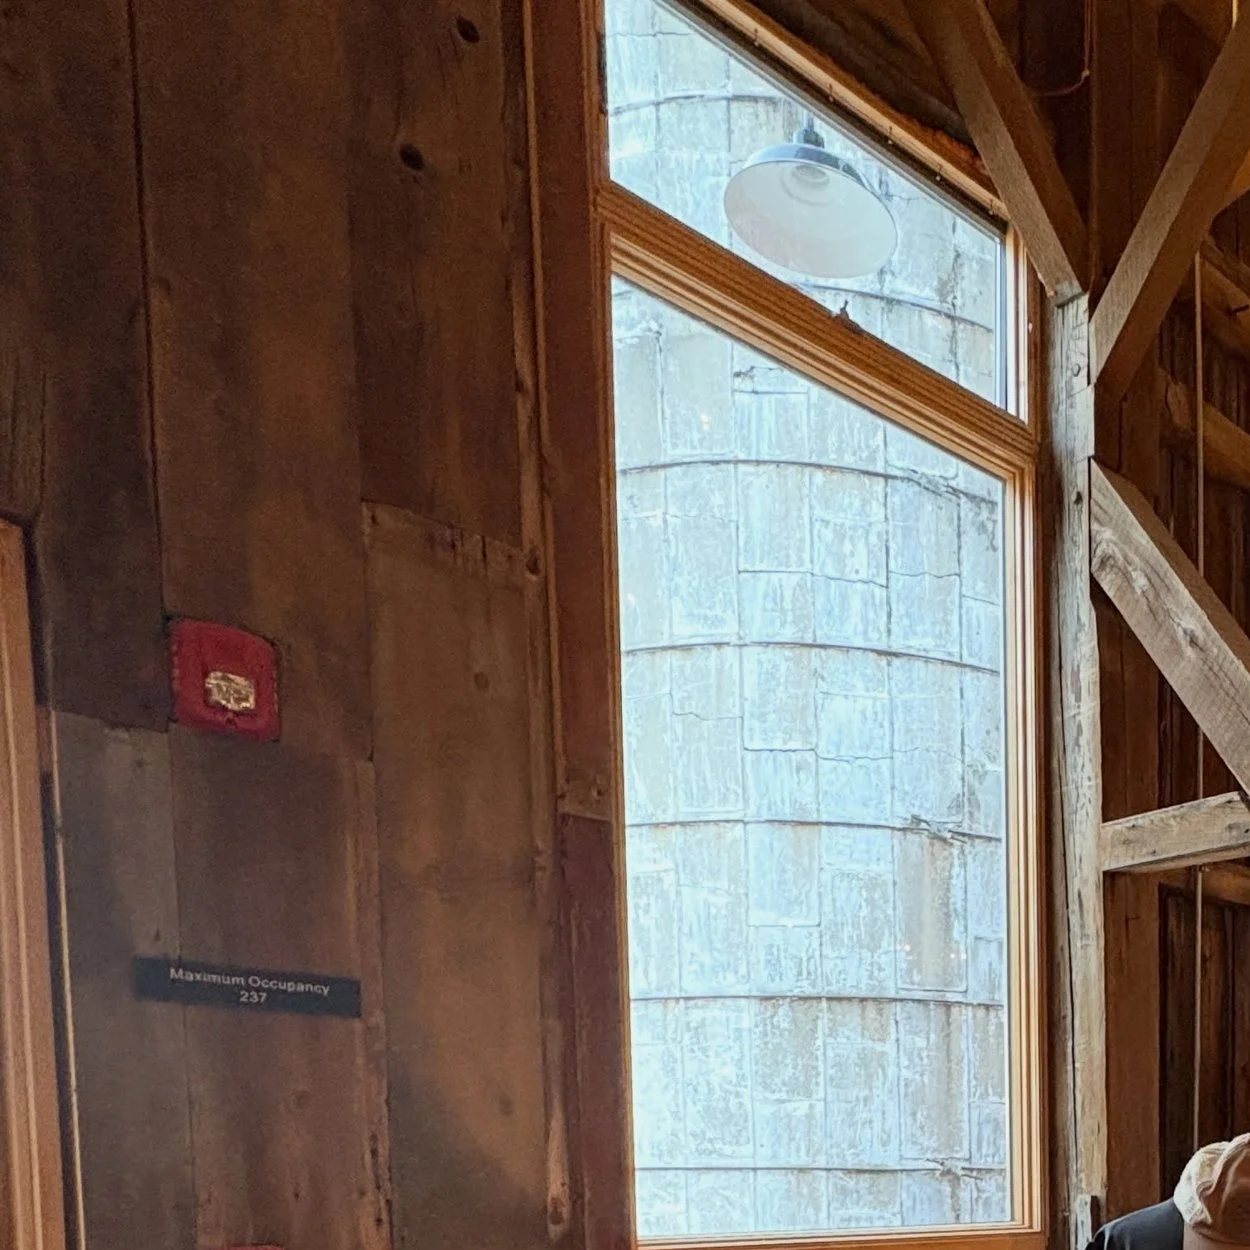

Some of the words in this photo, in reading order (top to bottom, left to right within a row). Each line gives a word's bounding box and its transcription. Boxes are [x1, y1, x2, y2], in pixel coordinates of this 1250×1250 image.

[169, 967, 245, 987] Maximum
[248, 975, 330, 996] Occupancy
[239, 990, 267, 1003] 237
